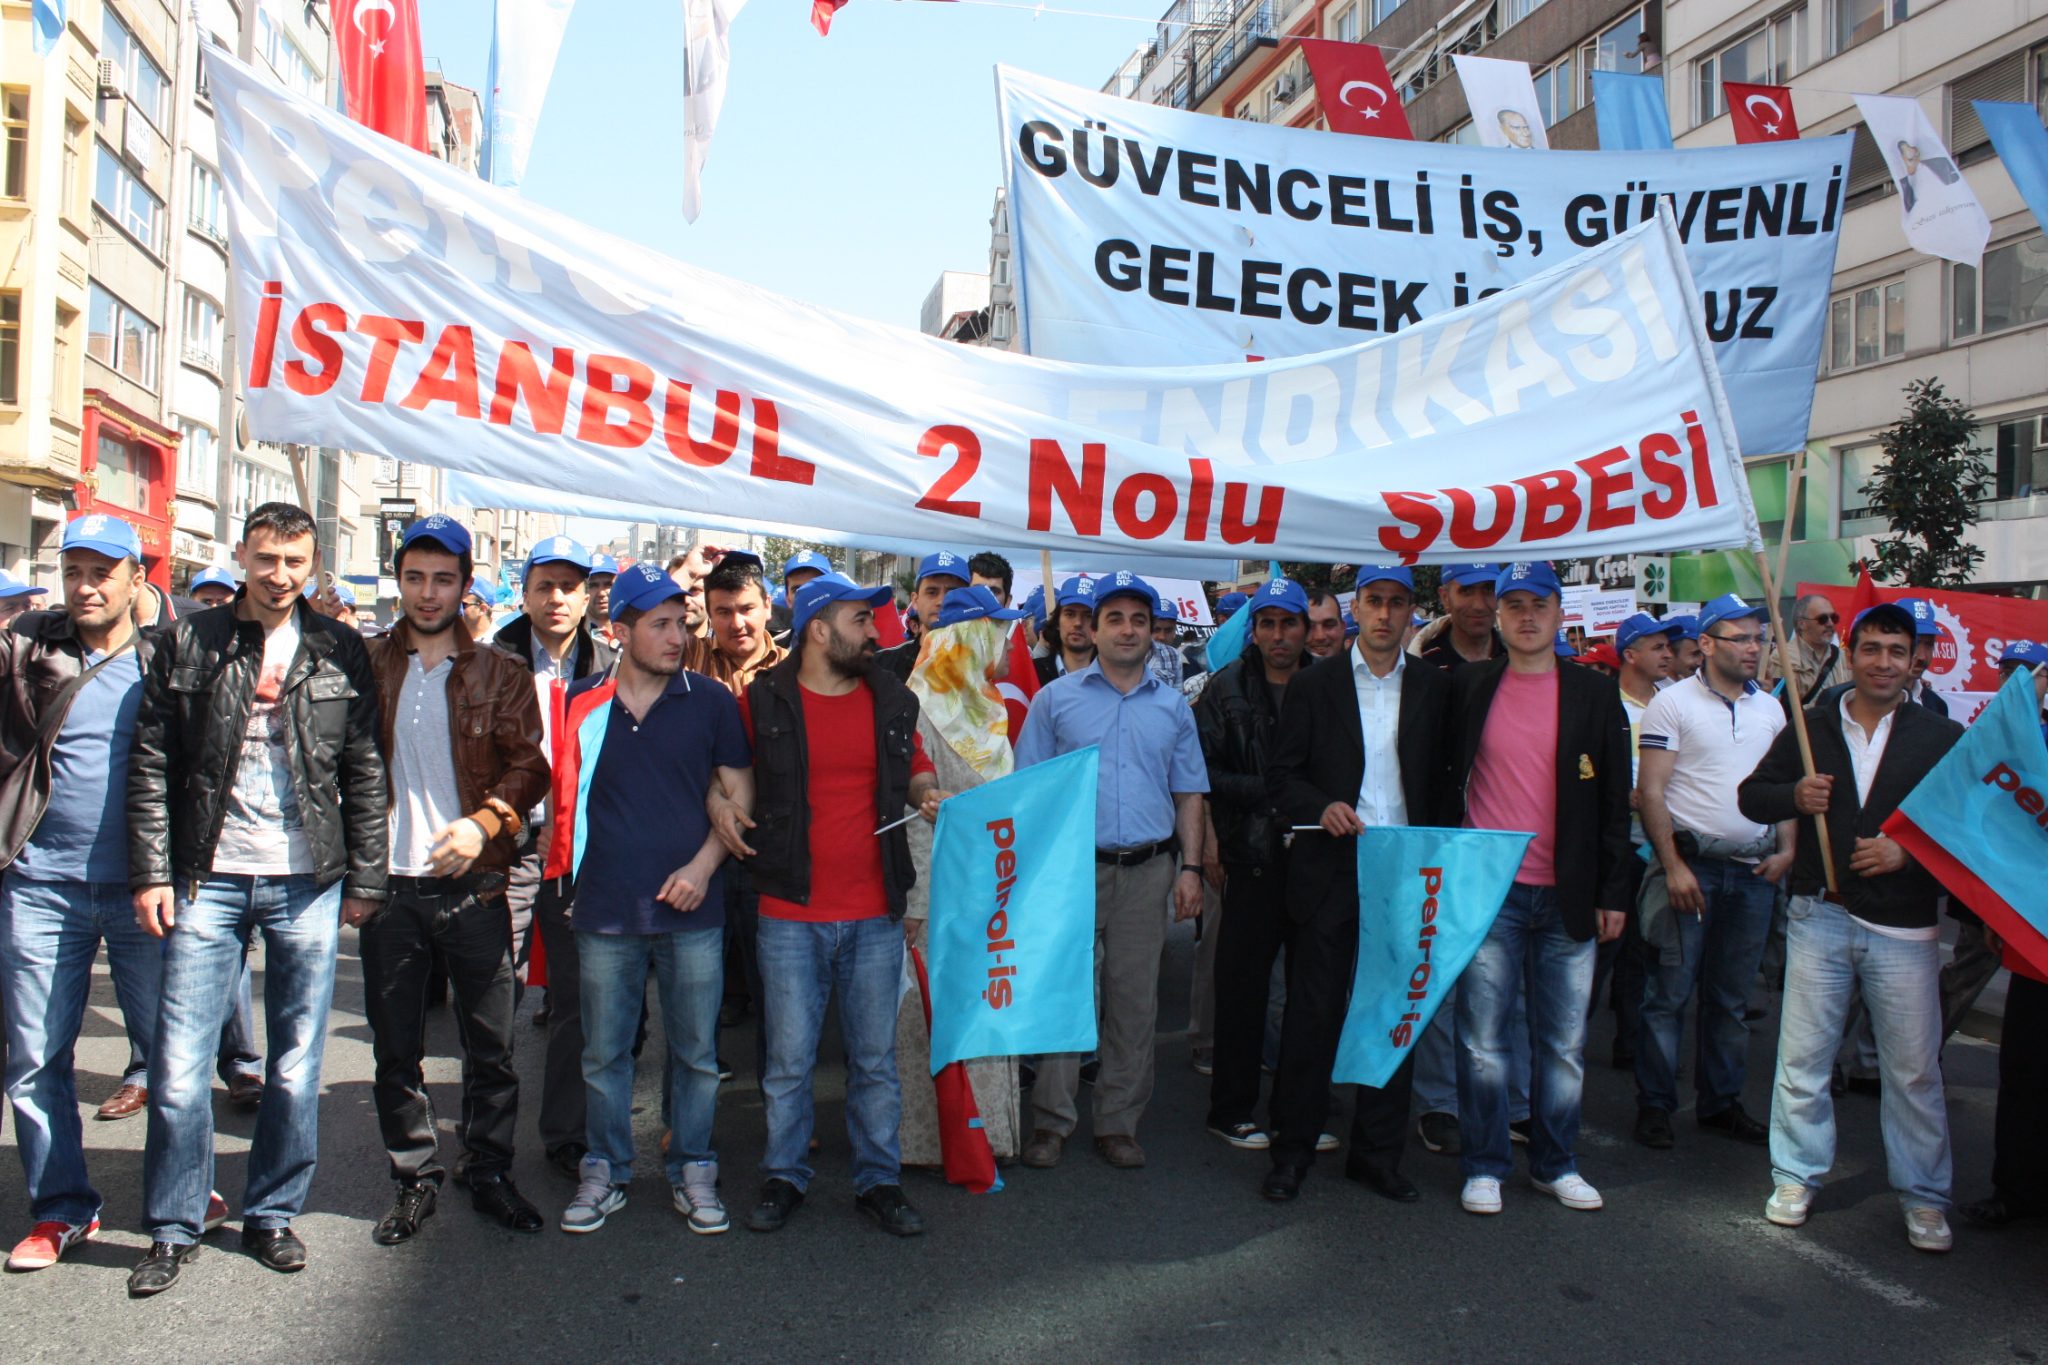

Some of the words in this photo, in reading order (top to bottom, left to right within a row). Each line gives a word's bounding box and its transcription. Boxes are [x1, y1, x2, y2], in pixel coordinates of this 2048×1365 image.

[1019, 121, 1434, 235] GÜVENCELİ
[1460, 174, 1543, 258] İŞ,
[1564, 165, 1843, 248] GÜVENLİ
[1066, 248, 1682, 466] ENDIKASI
[1095, 239, 1430, 334] GELECEK
[248, 281, 817, 487] İSTANBUL
[916, 424, 982, 519] 2
[1026, 439, 1286, 545] Nolu
[1378, 411, 1718, 567] ŞUBESİ
[1177, 597, 1199, 622] iş
[985, 816, 1018, 1010] petrol-iş
[1388, 866, 1444, 1049] petrol-iş
